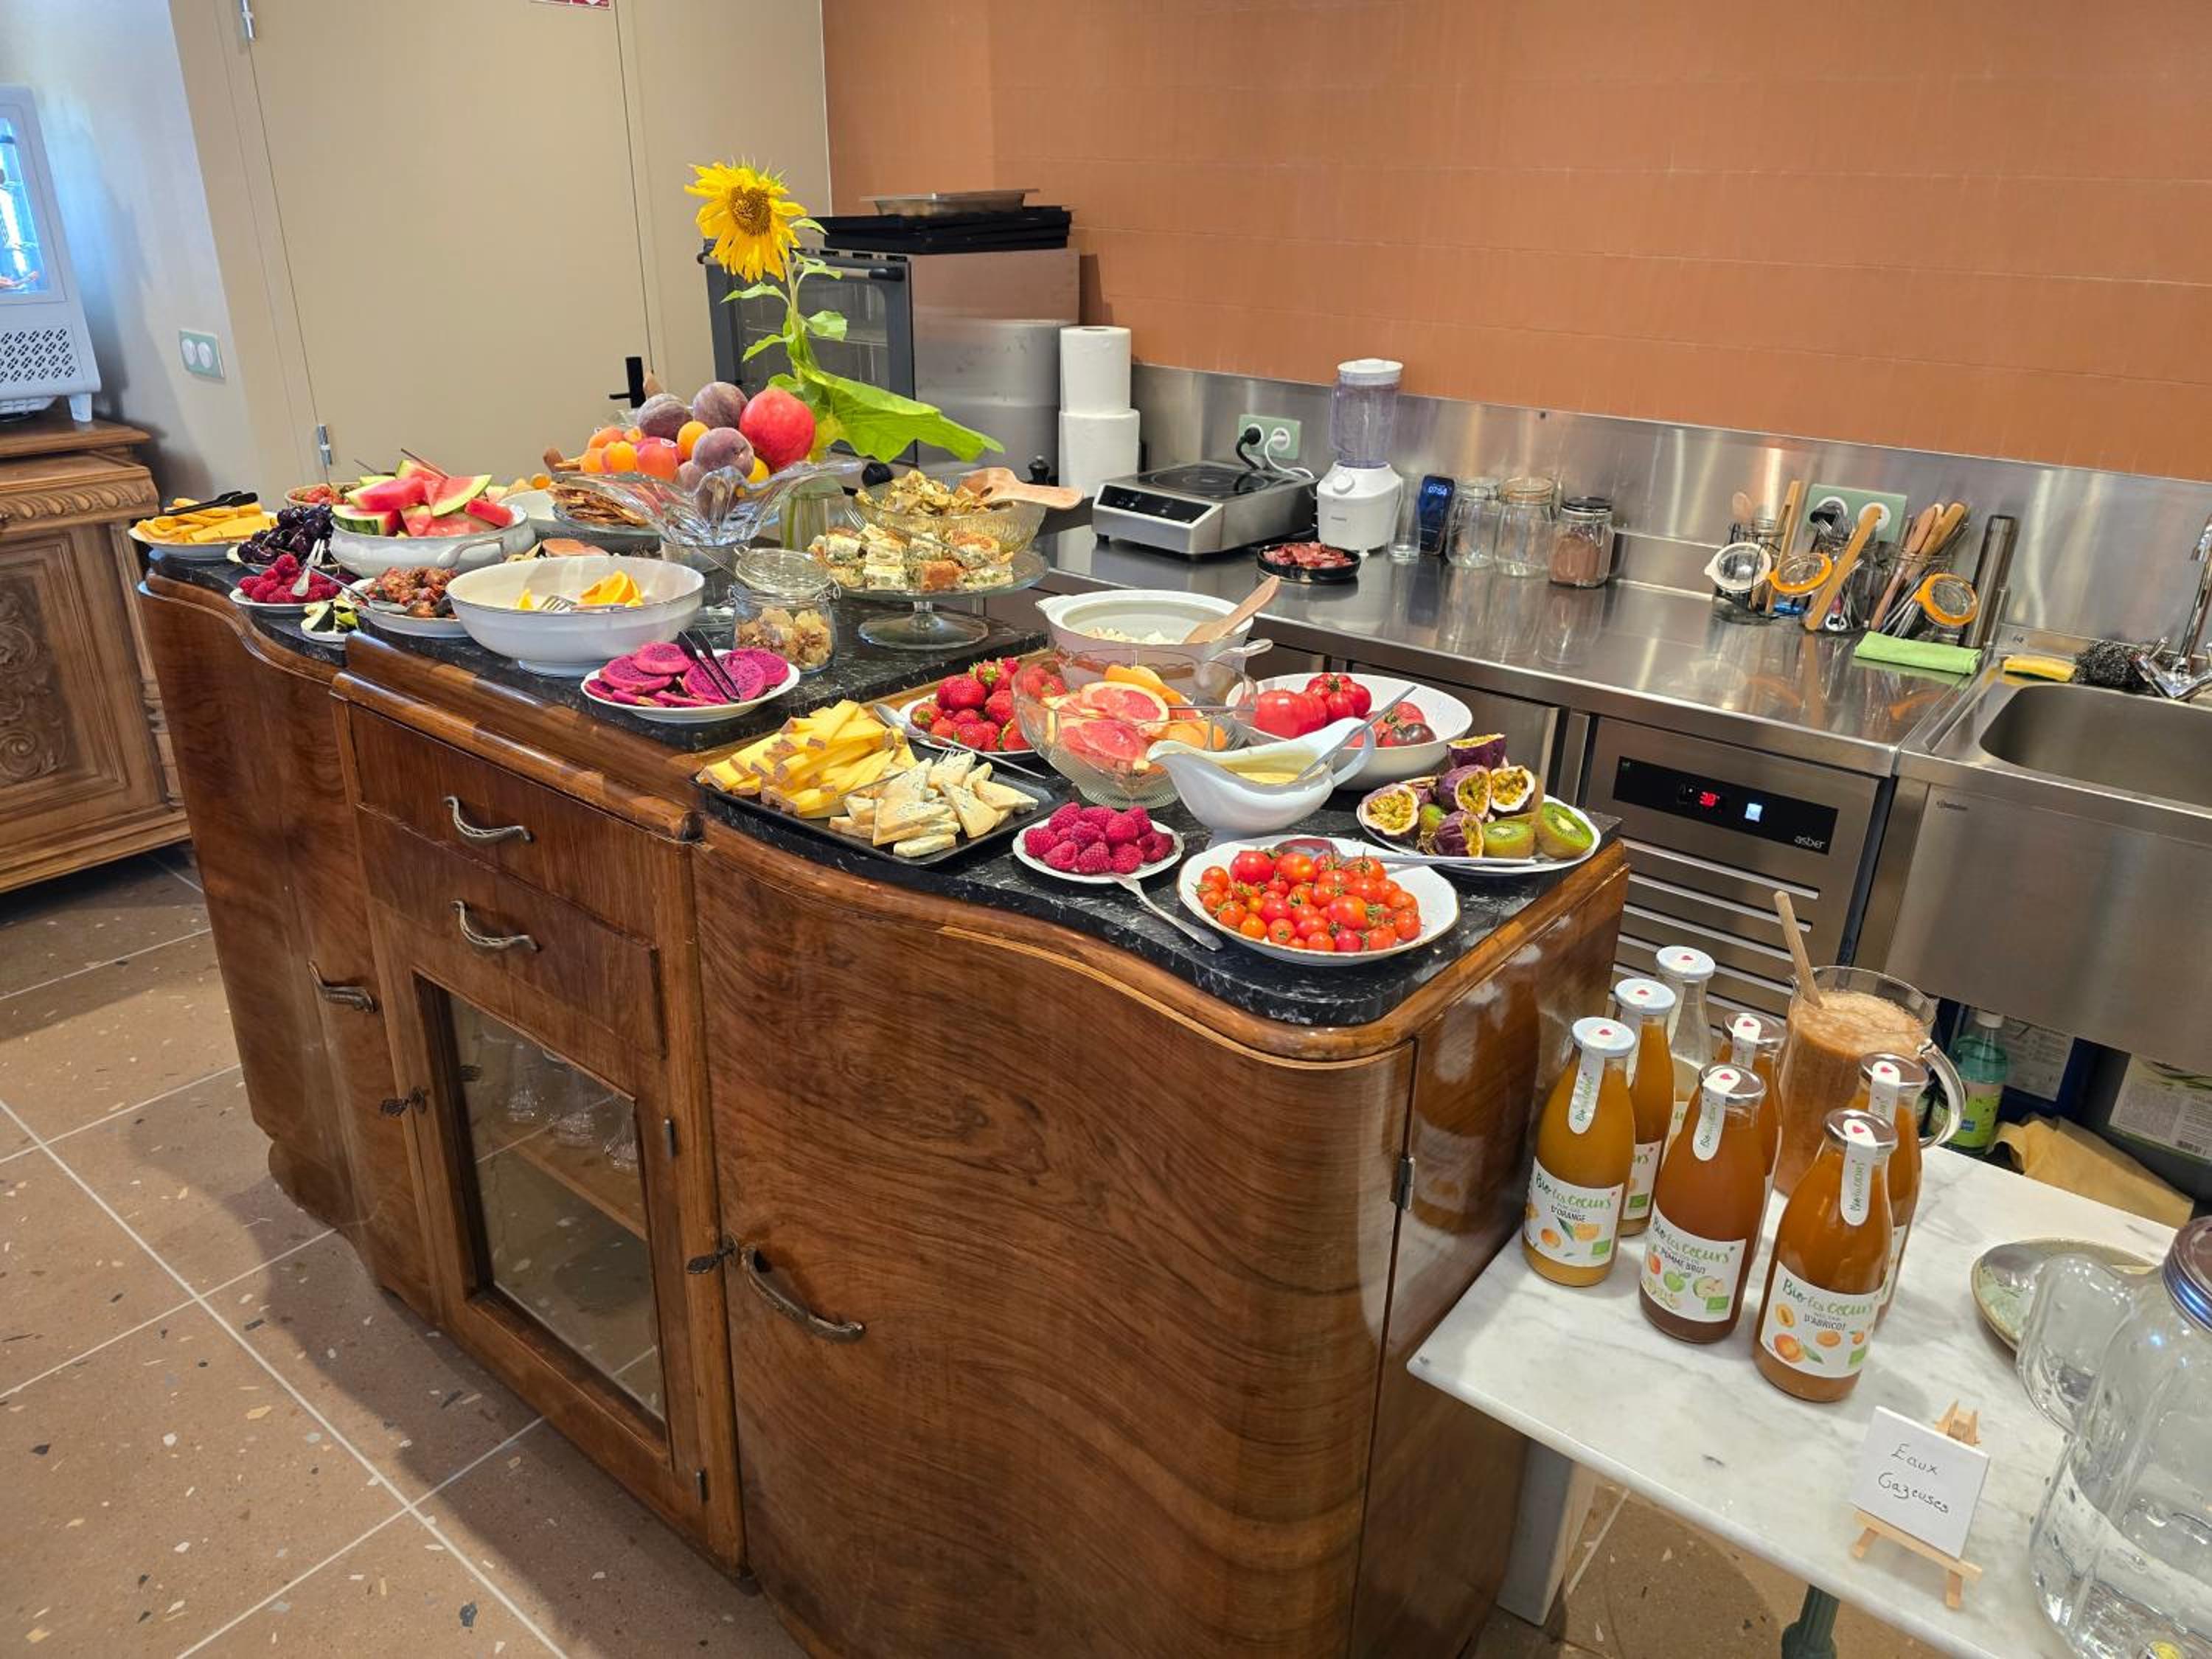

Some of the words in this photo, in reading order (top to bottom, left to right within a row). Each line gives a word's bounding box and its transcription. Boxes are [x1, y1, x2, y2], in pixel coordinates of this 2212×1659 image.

[1427, 485, 1447, 496] 07:54
[1794, 835, 1826, 849] asber
[1551, 1205, 1586, 1222] D'ORANGE
[1782, 1278, 1807, 1302] Bio
[1804, 1314, 1847, 1332] D'ABRICOT
[1891, 1443, 1938, 1475] Eaux
[1878, 1472, 1949, 1514] Gazeuses
